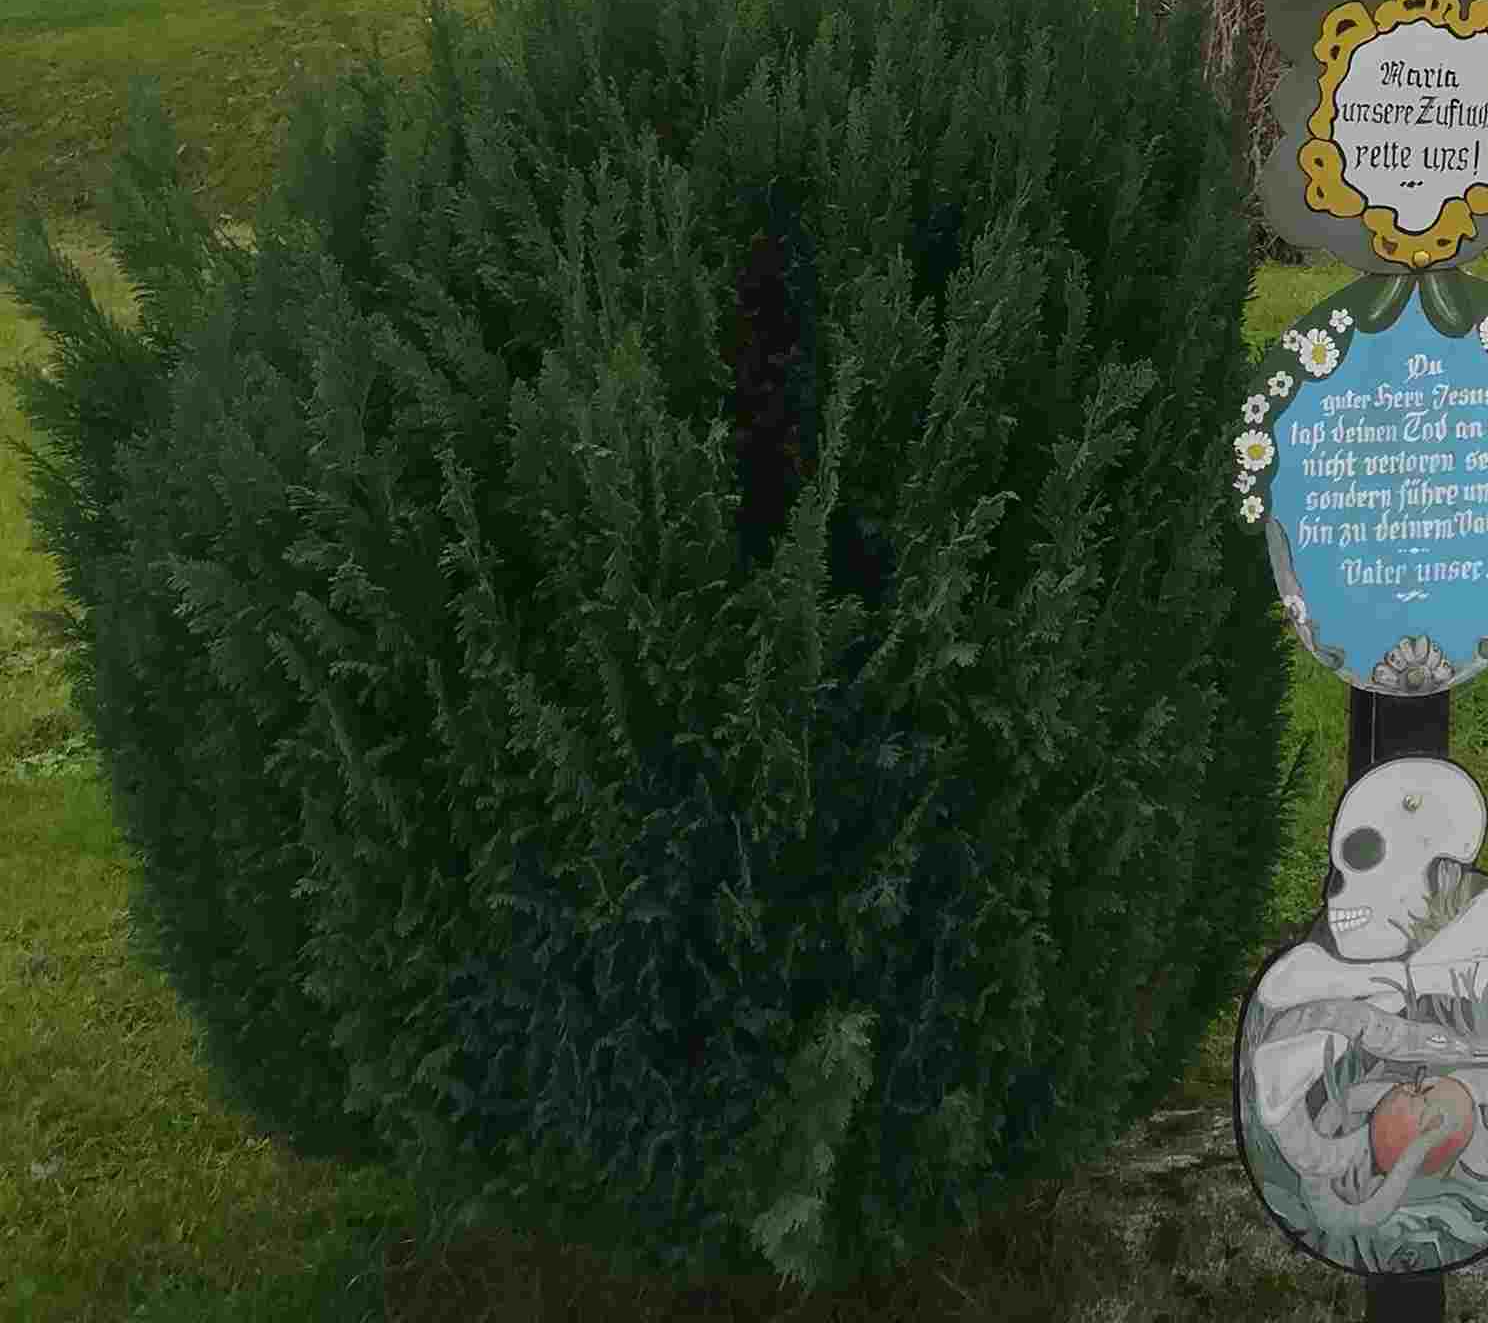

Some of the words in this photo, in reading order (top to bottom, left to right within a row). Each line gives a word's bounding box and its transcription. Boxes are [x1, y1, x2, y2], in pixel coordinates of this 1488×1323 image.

[1380, 60, 1460, 89] Maria
[1341, 102, 1412, 125] unsere
[1353, 141, 1412, 171] rette
[1422, 139, 1481, 176] uns!
[1405, 353, 1443, 380] Du
[1319, 389, 1372, 417] guter
[1374, 383, 1424, 412] Herr
[1331, 414, 1398, 445] deinen
[1402, 409, 1448, 444] Tod
[1455, 420, 1483, 441] an
[1302, 449, 1356, 483] nicht
[1364, 450, 1456, 476] verloren
[1304, 479, 1393, 511] sondern
[1397, 477, 1457, 514] führe
[1298, 514, 1333, 549] hin
[1338, 522, 1368, 549] zu
[1372, 508, 1457, 542] deinem
[1338, 558, 1408, 586] Vater
